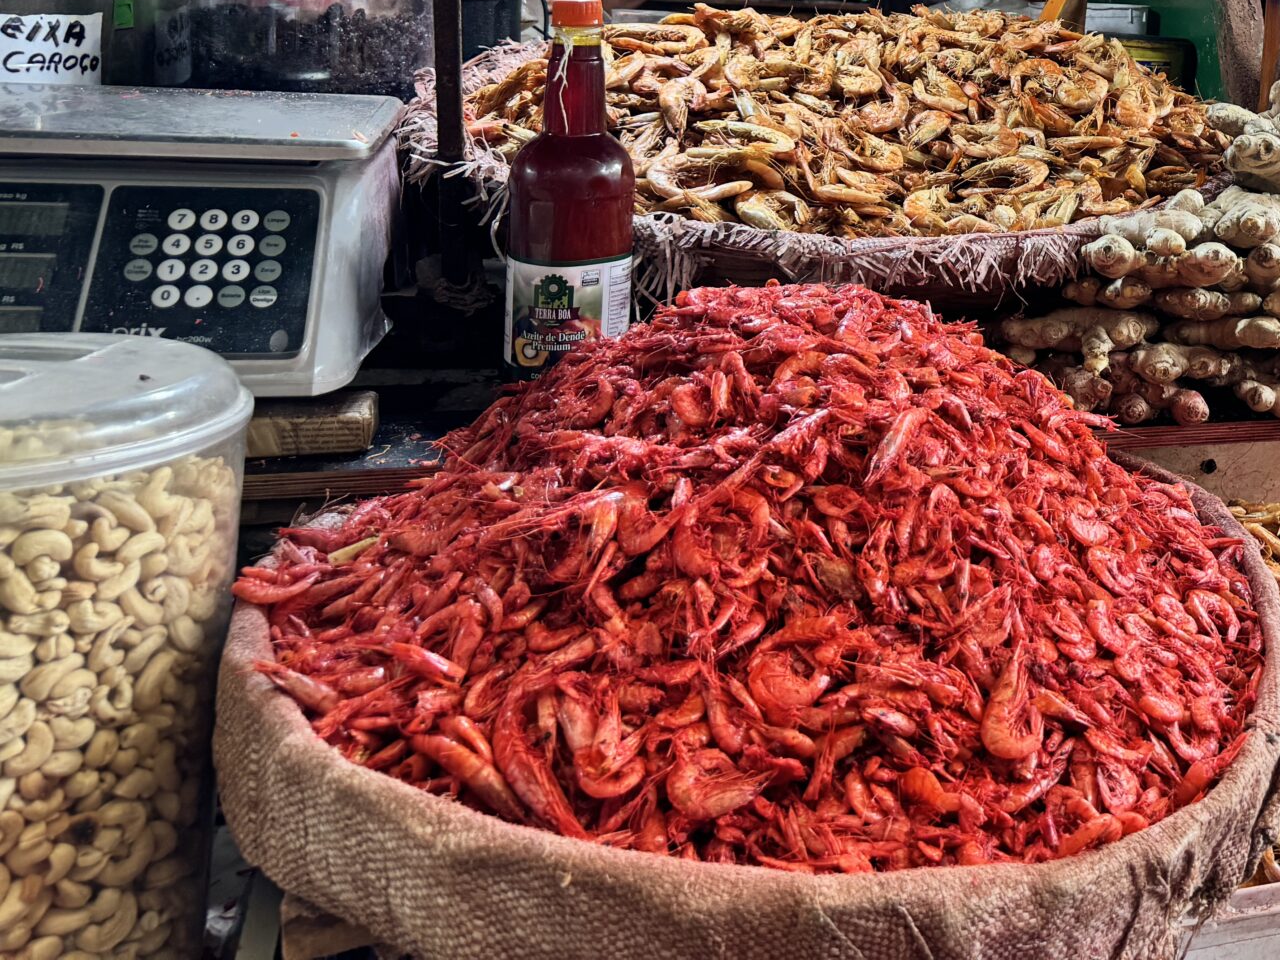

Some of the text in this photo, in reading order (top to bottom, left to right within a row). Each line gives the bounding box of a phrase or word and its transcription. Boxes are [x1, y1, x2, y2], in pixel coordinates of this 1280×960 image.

[177, 213, 187, 224] 7
[209, 214, 219, 225] 8
[241, 214, 251, 225] 9
[171, 239, 181, 249] 4
[204, 239, 213, 249] 5
[236, 240, 246, 250] 6
[168, 264, 174, 275] 1
[199, 264, 209, 275] 2
[231, 264, 241, 275] 3
[161, 290, 171, 301] 0
[534, 308, 572, 320] TERRA BOA
[521, 330, 544, 341] Azeite
[545, 332, 557, 342] de
[531, 342, 571, 351] Premium
